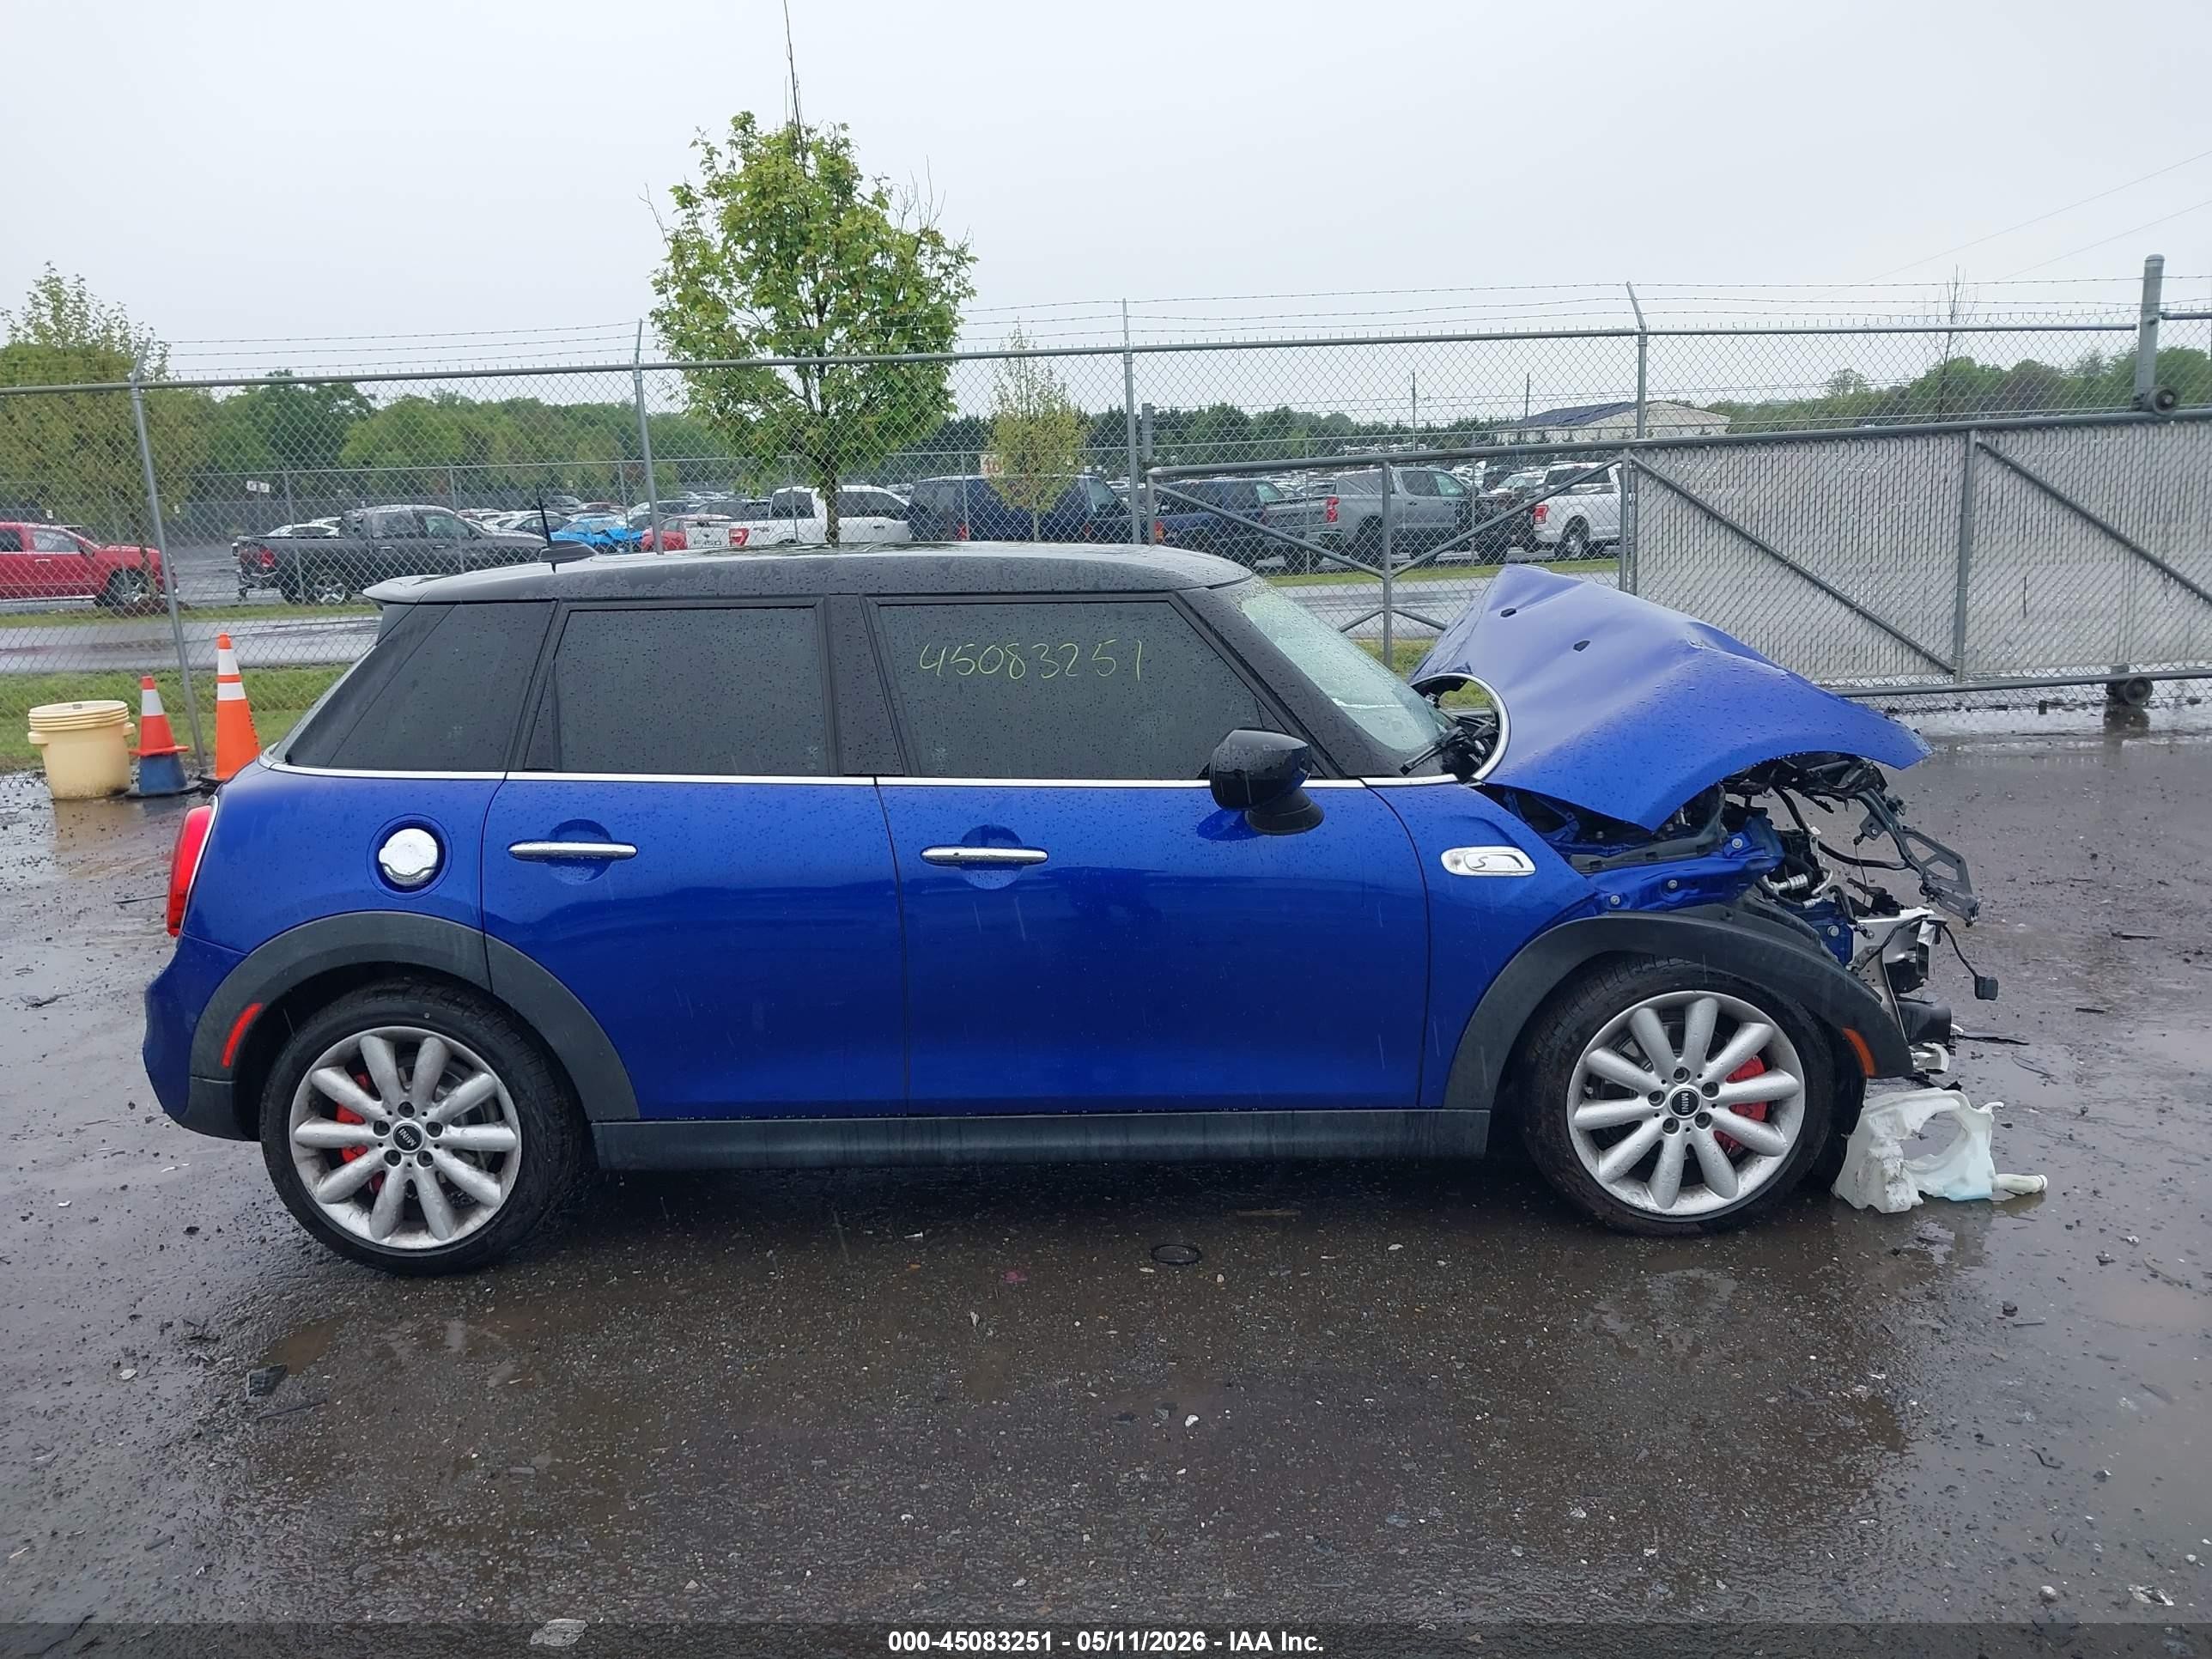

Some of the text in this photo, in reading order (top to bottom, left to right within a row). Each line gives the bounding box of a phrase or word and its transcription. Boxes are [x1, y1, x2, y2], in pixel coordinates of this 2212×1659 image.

[920, 639, 1143, 681] 45083251
[1680, 1092, 1690, 1113] MINI
[398, 1127, 416, 1147] MINI
